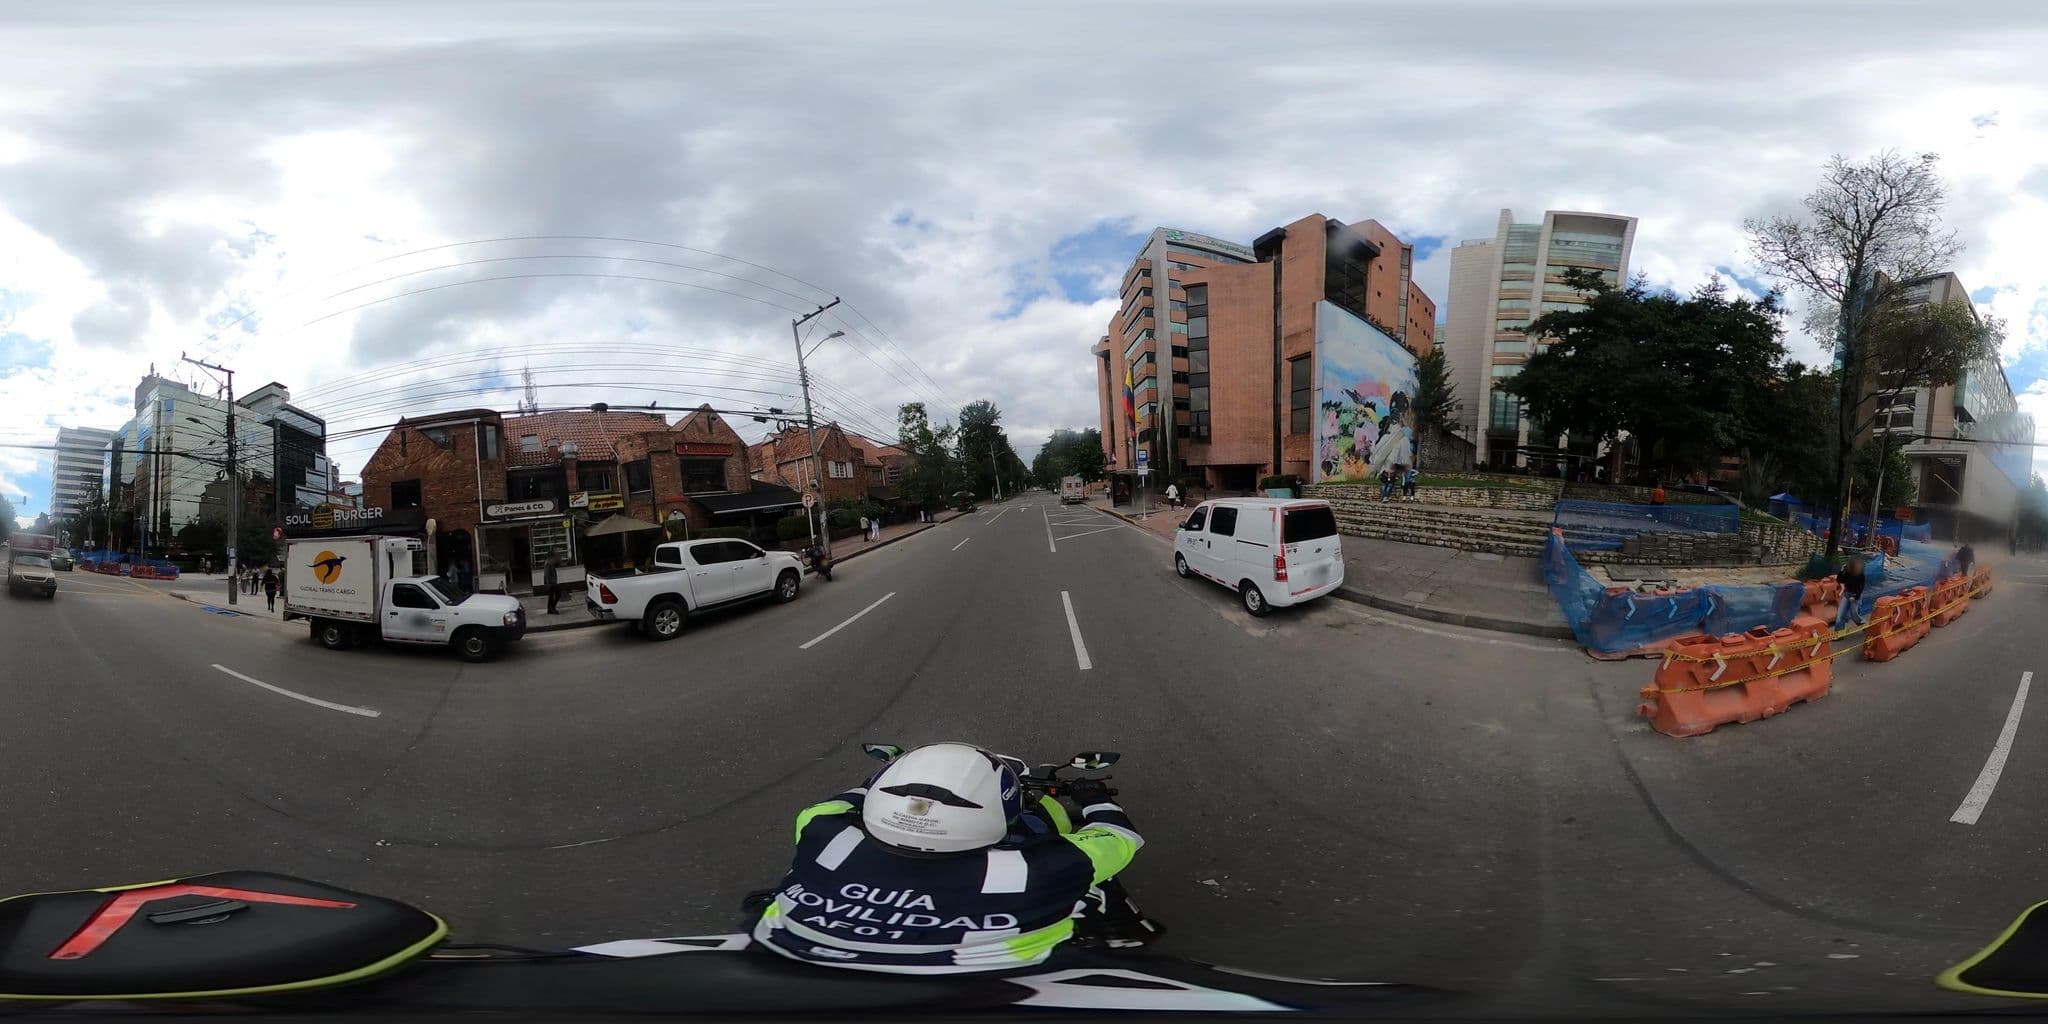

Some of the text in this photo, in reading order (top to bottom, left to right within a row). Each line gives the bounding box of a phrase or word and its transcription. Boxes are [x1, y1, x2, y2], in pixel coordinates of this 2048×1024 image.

[285, 507, 383, 525] SOUL BURGER
[299, 585, 356, 595] GLOBAL TRANS CARGO
[785, 883, 1019, 930] MOVILIDAD
[839, 882, 936, 911] GUÍA
